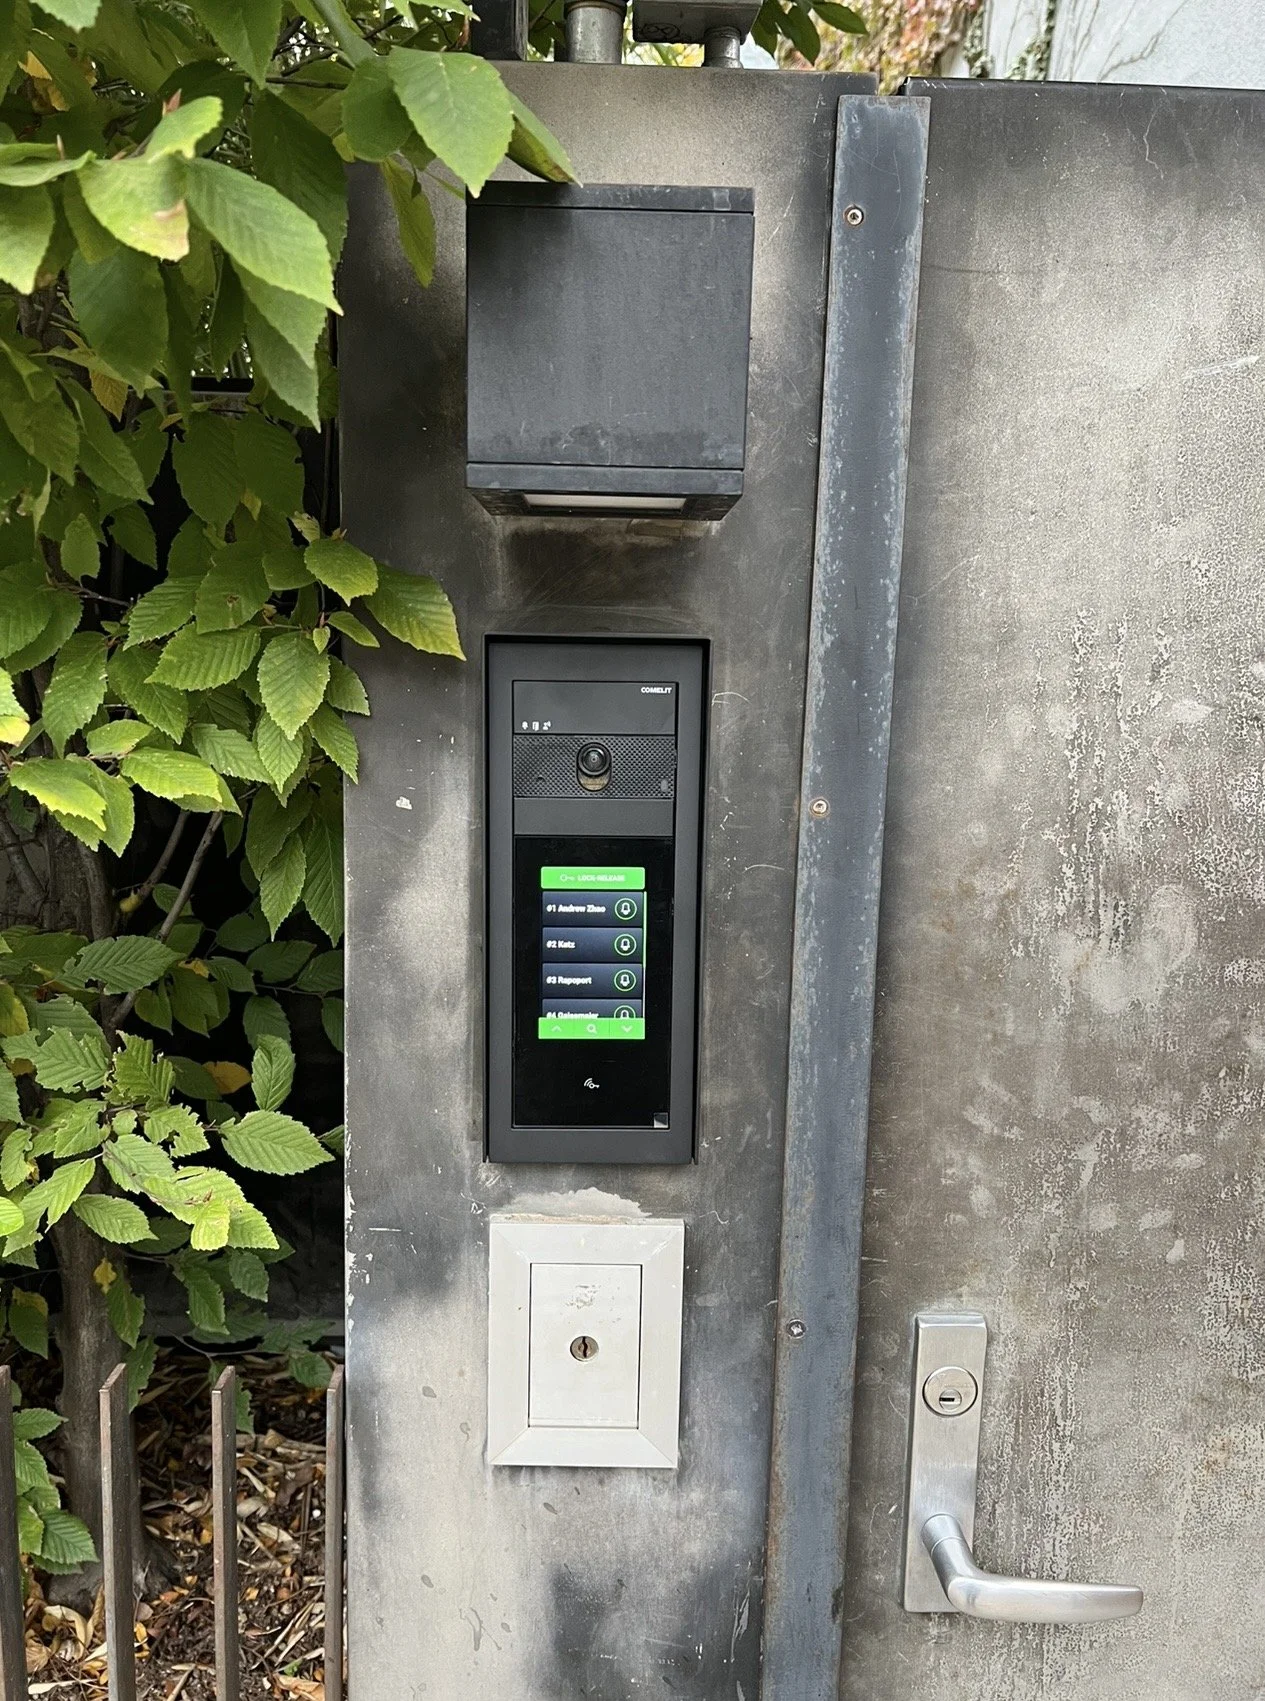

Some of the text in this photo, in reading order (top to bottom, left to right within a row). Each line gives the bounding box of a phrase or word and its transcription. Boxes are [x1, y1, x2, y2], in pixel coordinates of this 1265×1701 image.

[641, 686, 672, 694] COMELIT
[546, 904, 606, 912] #1 Andrew Zhao
[546, 940, 575, 948] #2 Katz
[546, 976, 592, 985] #3 Rapoport
